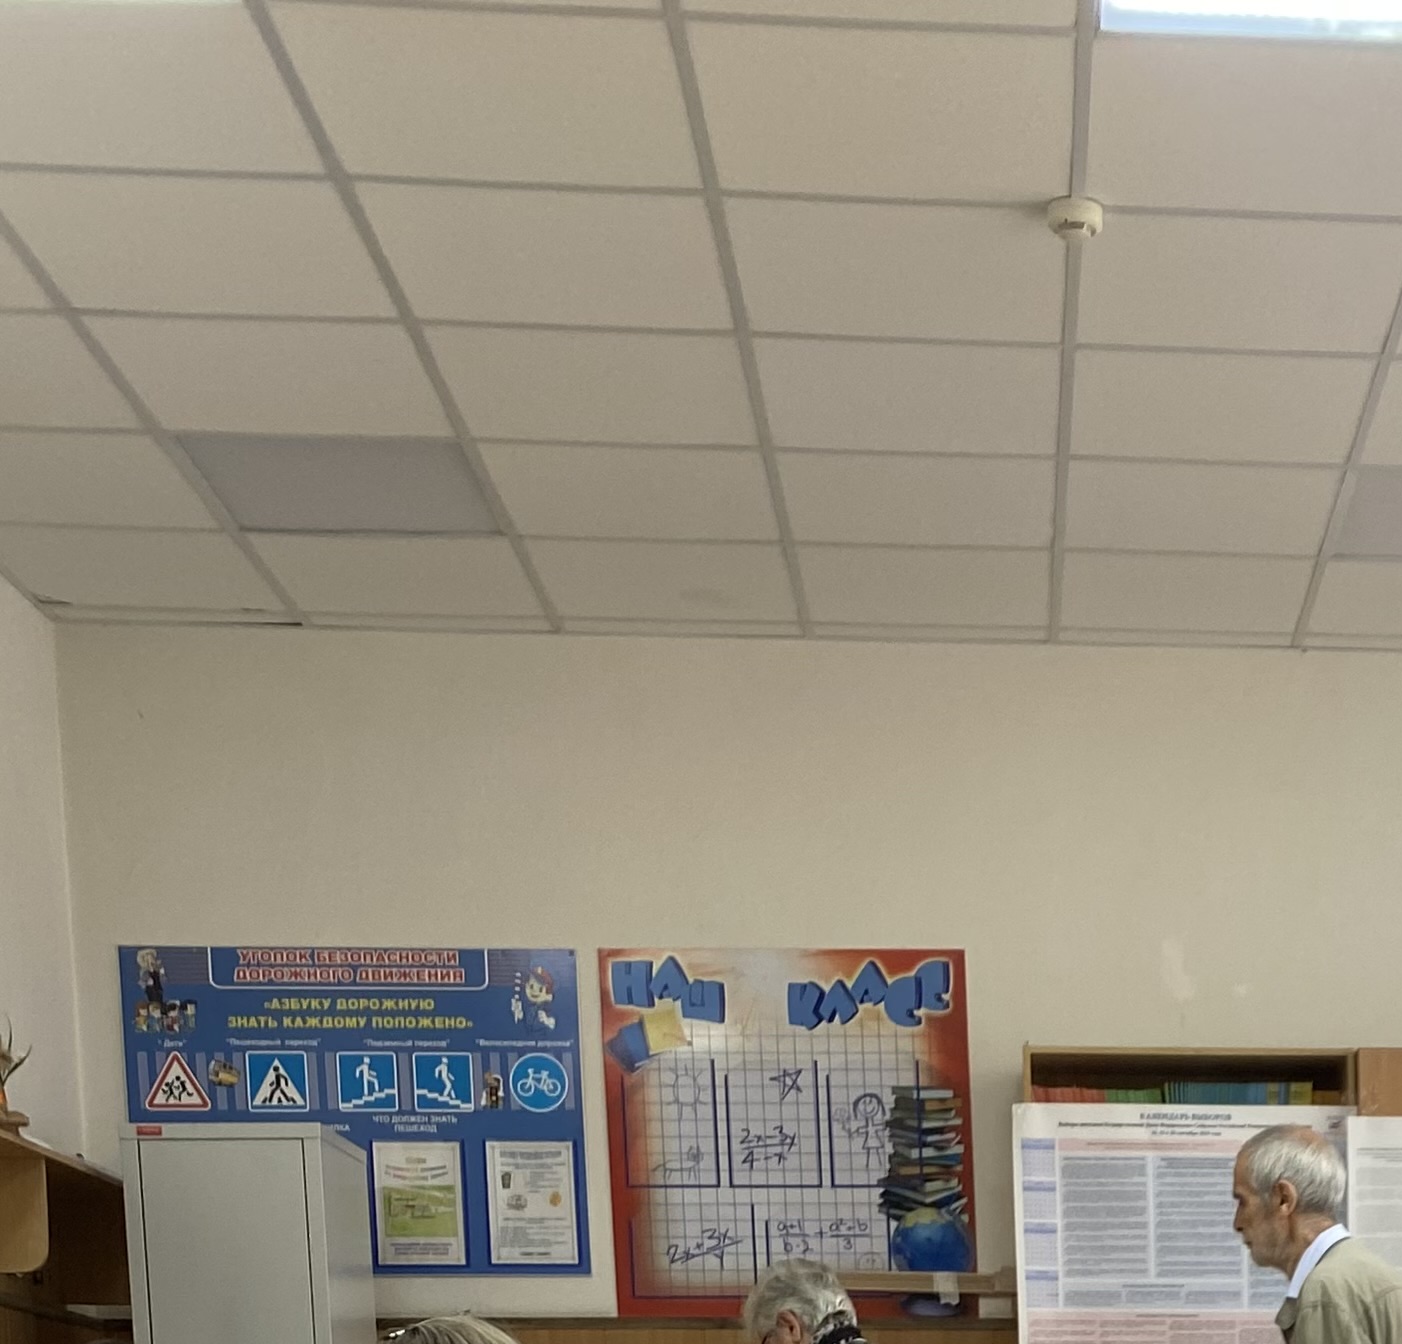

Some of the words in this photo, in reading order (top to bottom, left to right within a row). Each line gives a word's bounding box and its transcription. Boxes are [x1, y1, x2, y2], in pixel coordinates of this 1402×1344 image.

[238, 949, 312, 965] УГОЛОК
[314, 949, 458, 966] БЕЗОПАСНОСТИ
[234, 967, 353, 983] ДОРОЖНОГО
[356, 968, 465, 983] ДВИЖЕНИЯ
[611, 955, 725, 1024] НАШ
[787, 959, 951, 1030] КЛАСС
[336, 998, 435, 1010] ДОРОЖНУЮ
[227, 1016, 278, 1029] ЗНАТЬ
[283, 1016, 367, 1029] КАЖДОМУ
